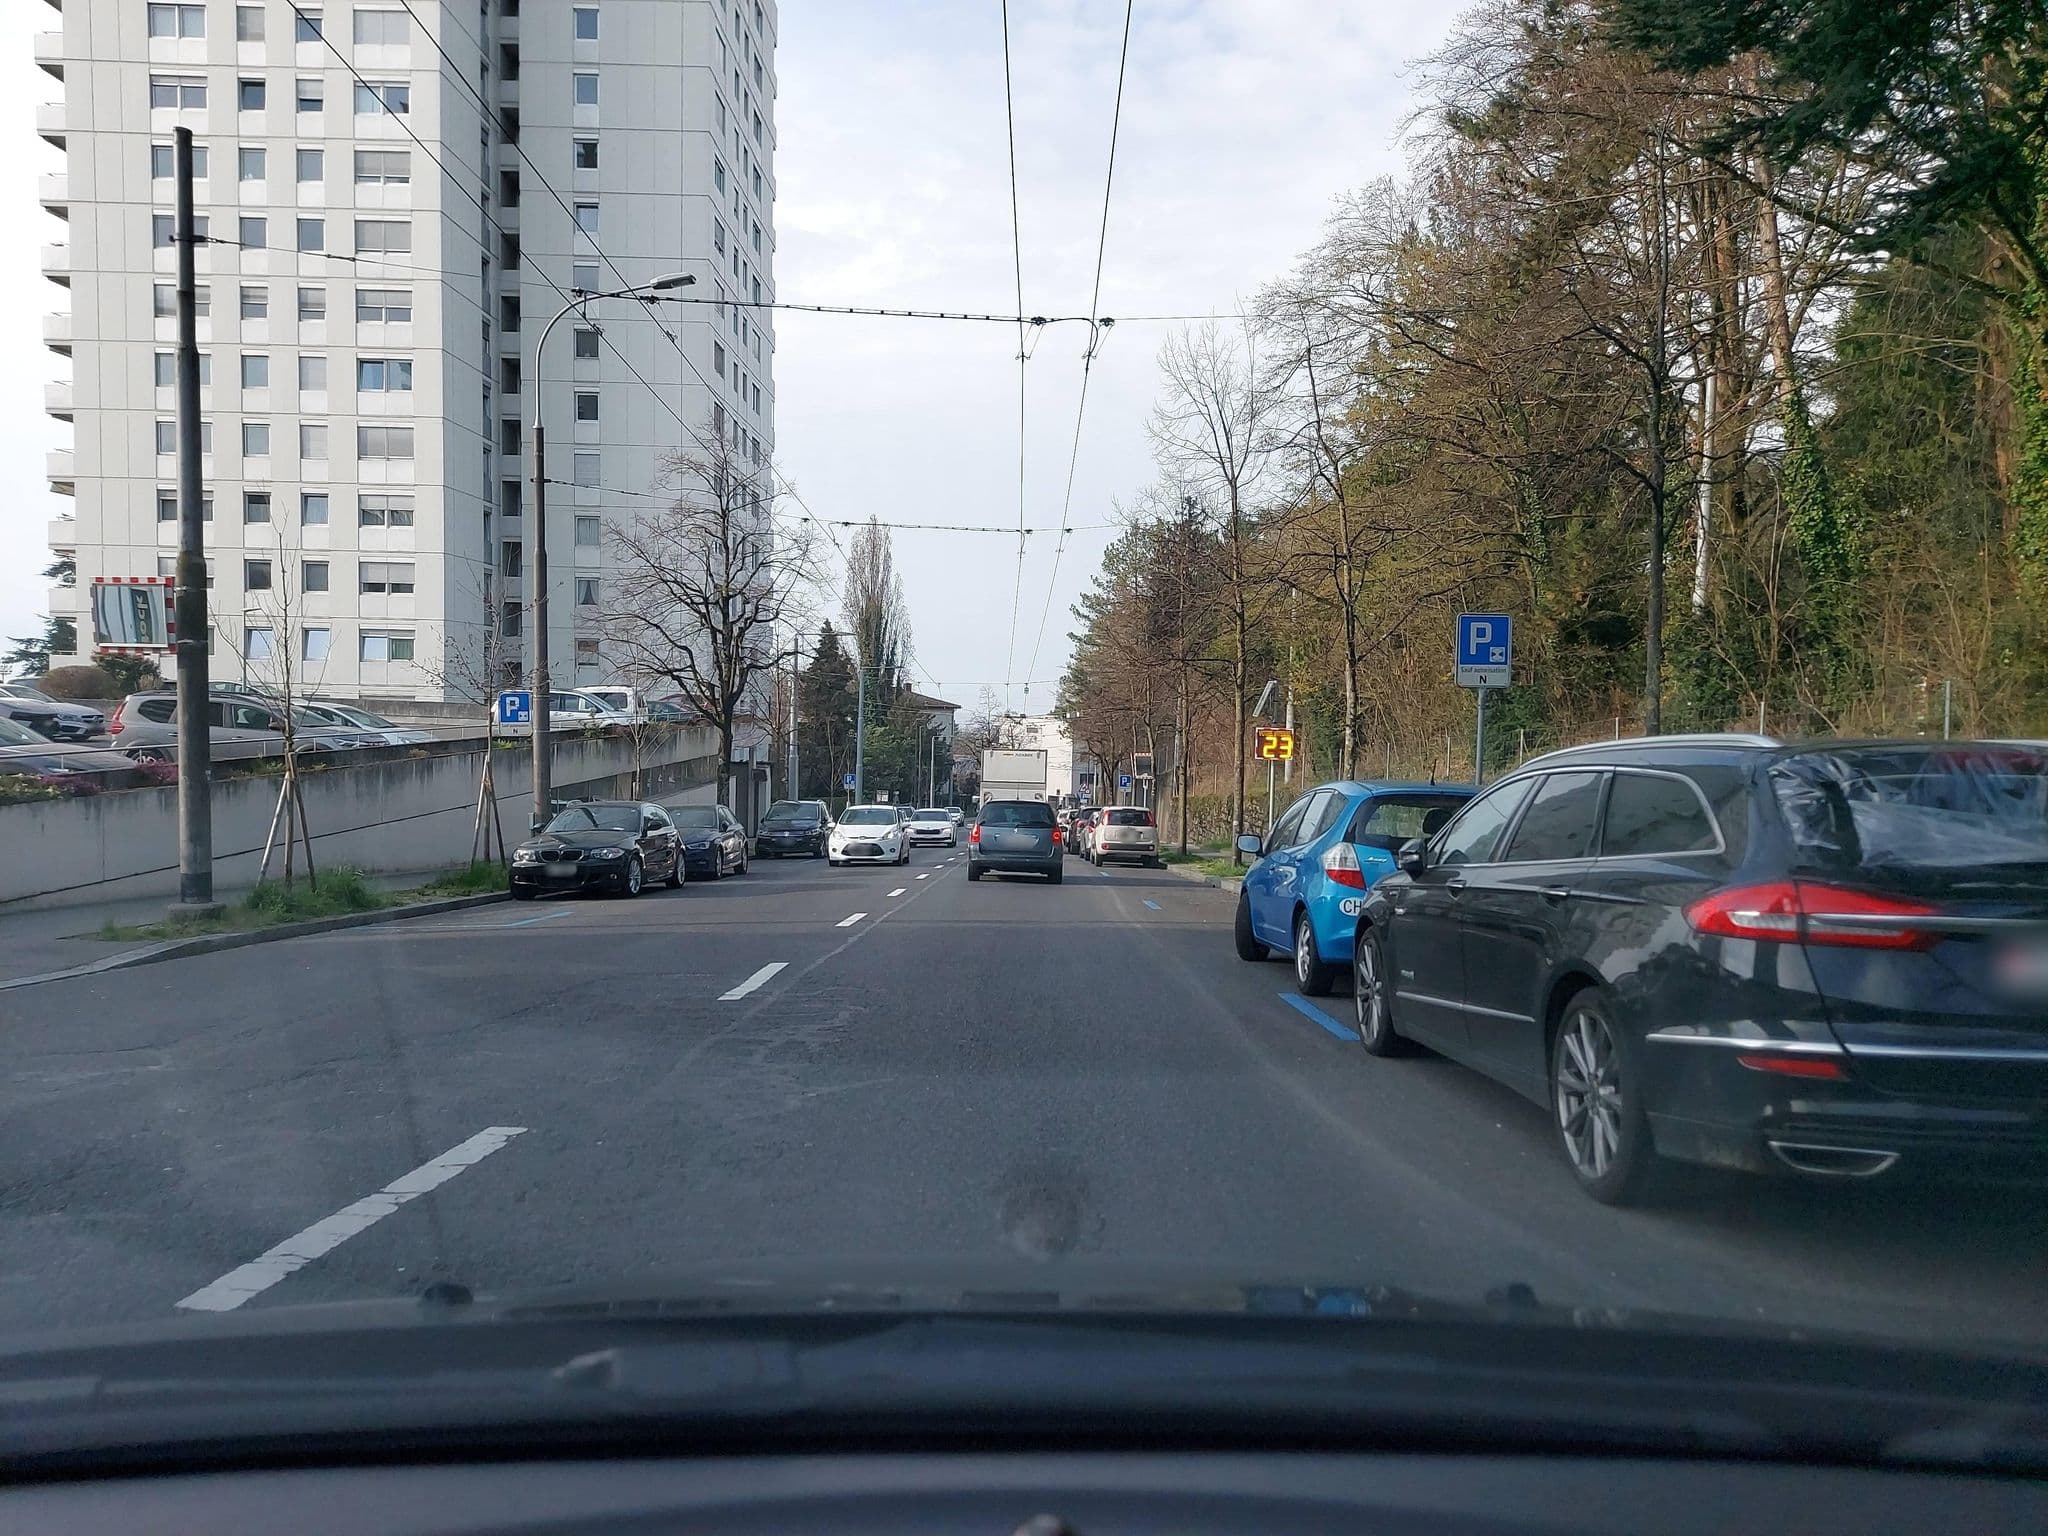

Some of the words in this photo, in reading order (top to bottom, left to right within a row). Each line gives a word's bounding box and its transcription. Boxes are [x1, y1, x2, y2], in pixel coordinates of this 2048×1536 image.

[1469, 622, 1492, 655] P
[1479, 675, 1487, 684] N
[505, 696, 520, 717] P
[1263, 736, 1292, 758] 23
[1122, 777, 1128, 785] P
[1343, 899, 1362, 913] CH
